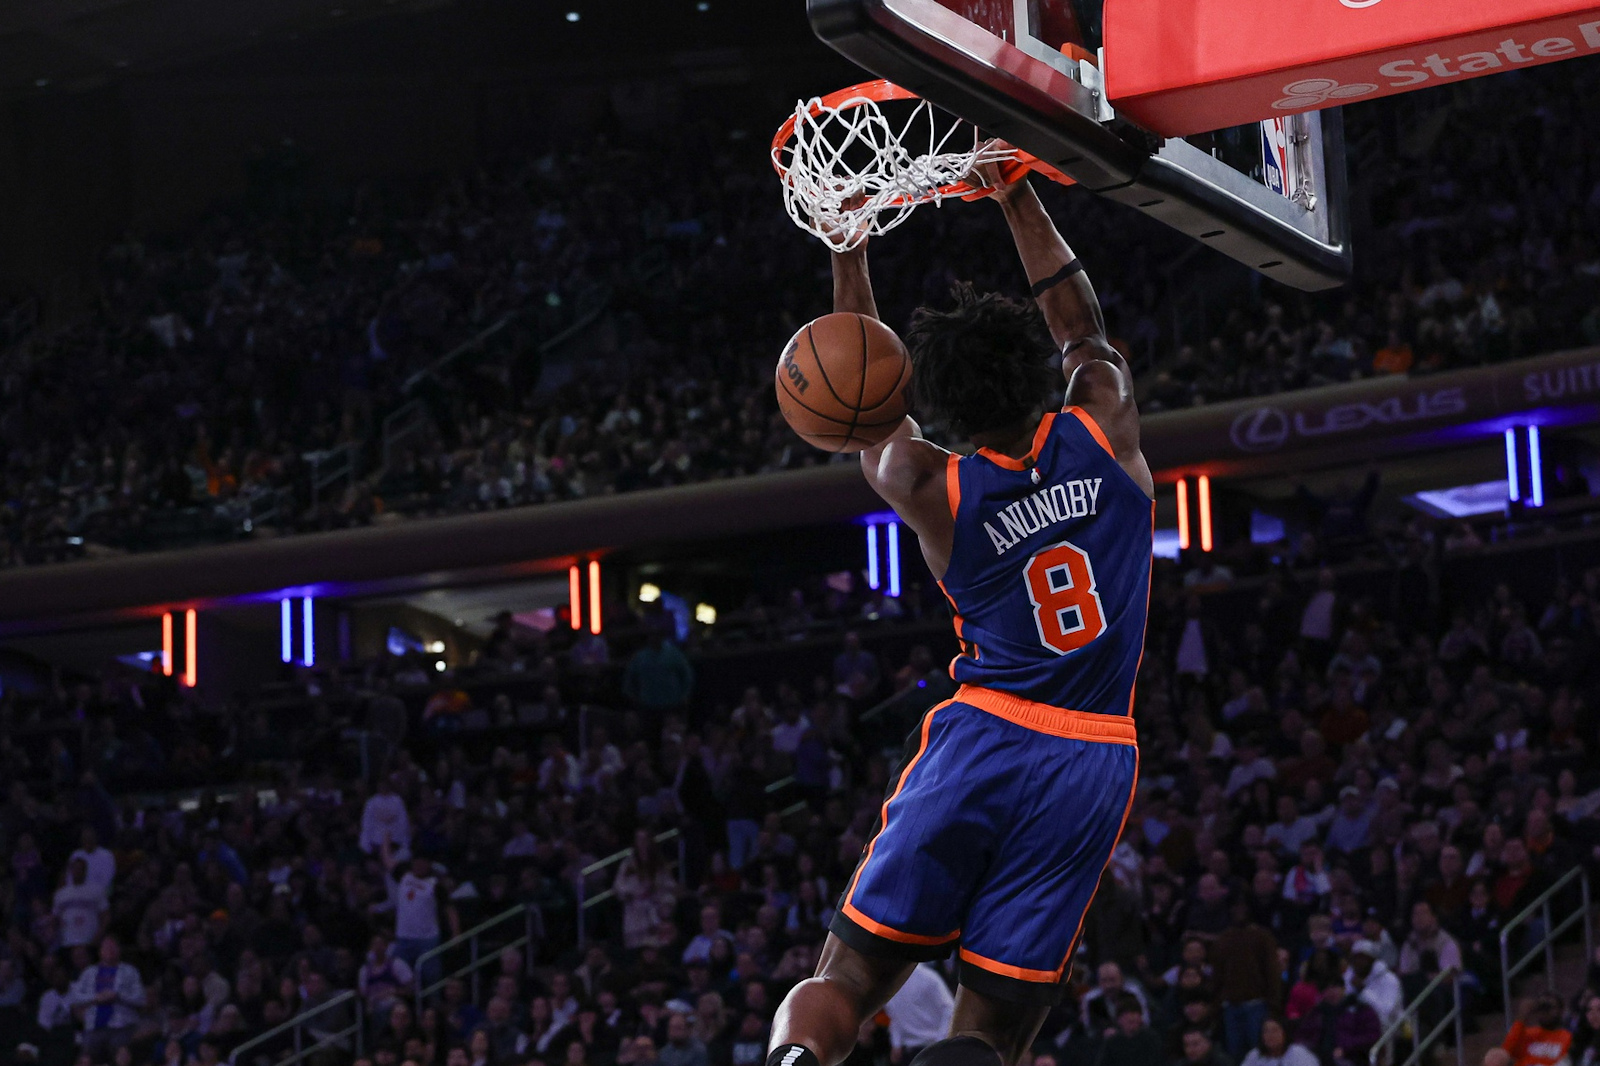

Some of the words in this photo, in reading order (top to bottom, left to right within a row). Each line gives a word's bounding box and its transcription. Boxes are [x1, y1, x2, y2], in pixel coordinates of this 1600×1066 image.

[1378, 38, 1577, 87] State
[1523, 364, 1600, 401] SUIT
[1294, 387, 1467, 436] LEXUS
[983, 478, 1102, 555] ANUNOBY
[1022, 540, 1107, 656] 8
